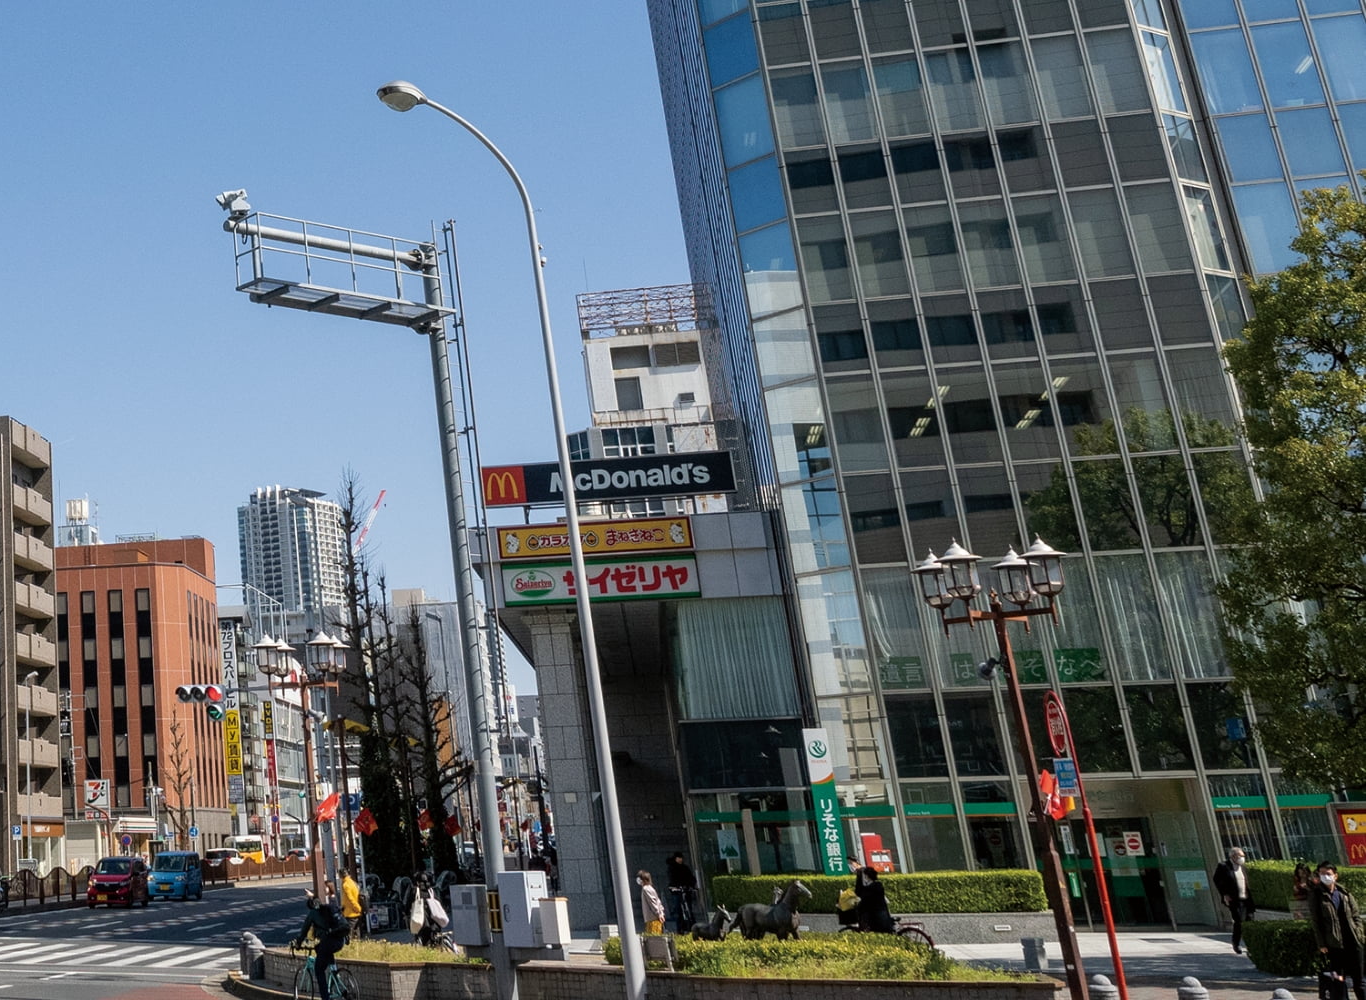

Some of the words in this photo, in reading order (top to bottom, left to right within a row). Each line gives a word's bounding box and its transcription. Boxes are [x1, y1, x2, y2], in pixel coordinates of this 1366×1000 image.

[549, 463, 710, 493] McDonald's
[606, 528, 665, 546] まねきねこ
[820, 798, 843, 872] りそな銀行
